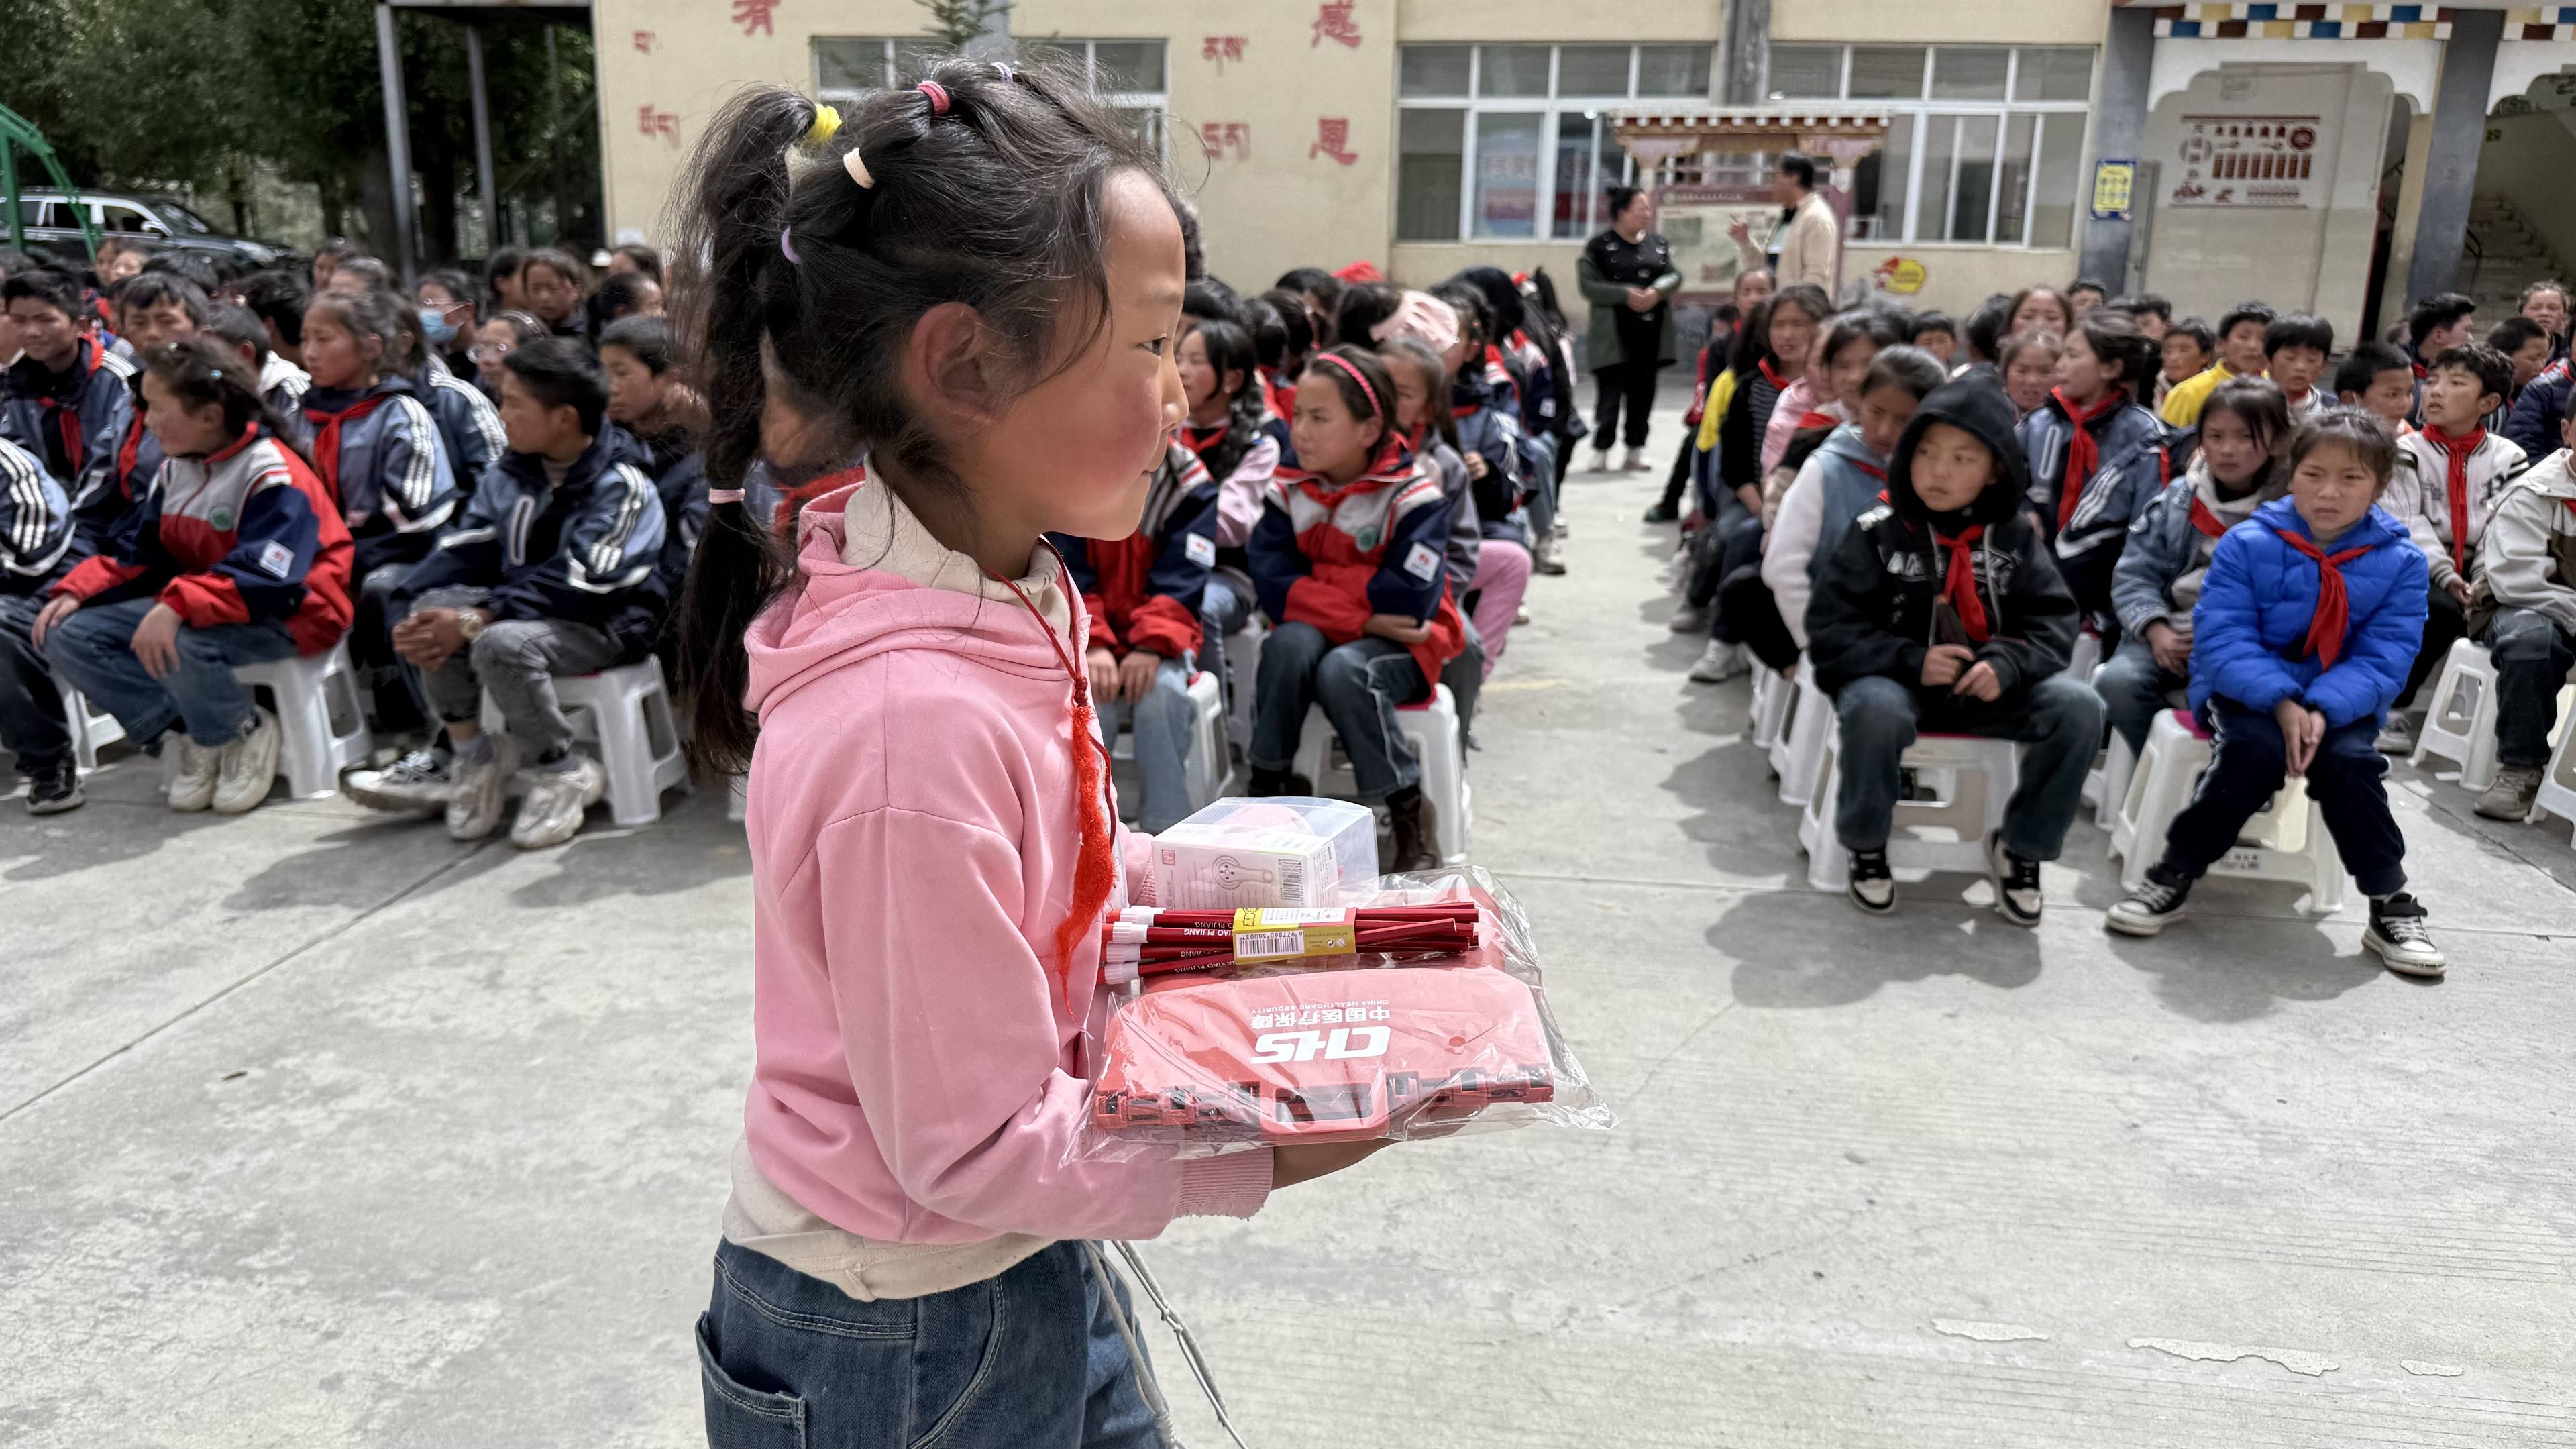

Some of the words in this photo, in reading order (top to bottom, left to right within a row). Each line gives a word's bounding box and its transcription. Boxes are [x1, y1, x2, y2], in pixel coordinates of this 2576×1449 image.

[1299, 1000, 1358, 1010] HEALTHCARE
[1360, 999, 1389, 1007] CHINA
[1251, 1005, 1296, 1014] SECURITY
[1250, 1006, 1391, 1029] 中国医疗保障
